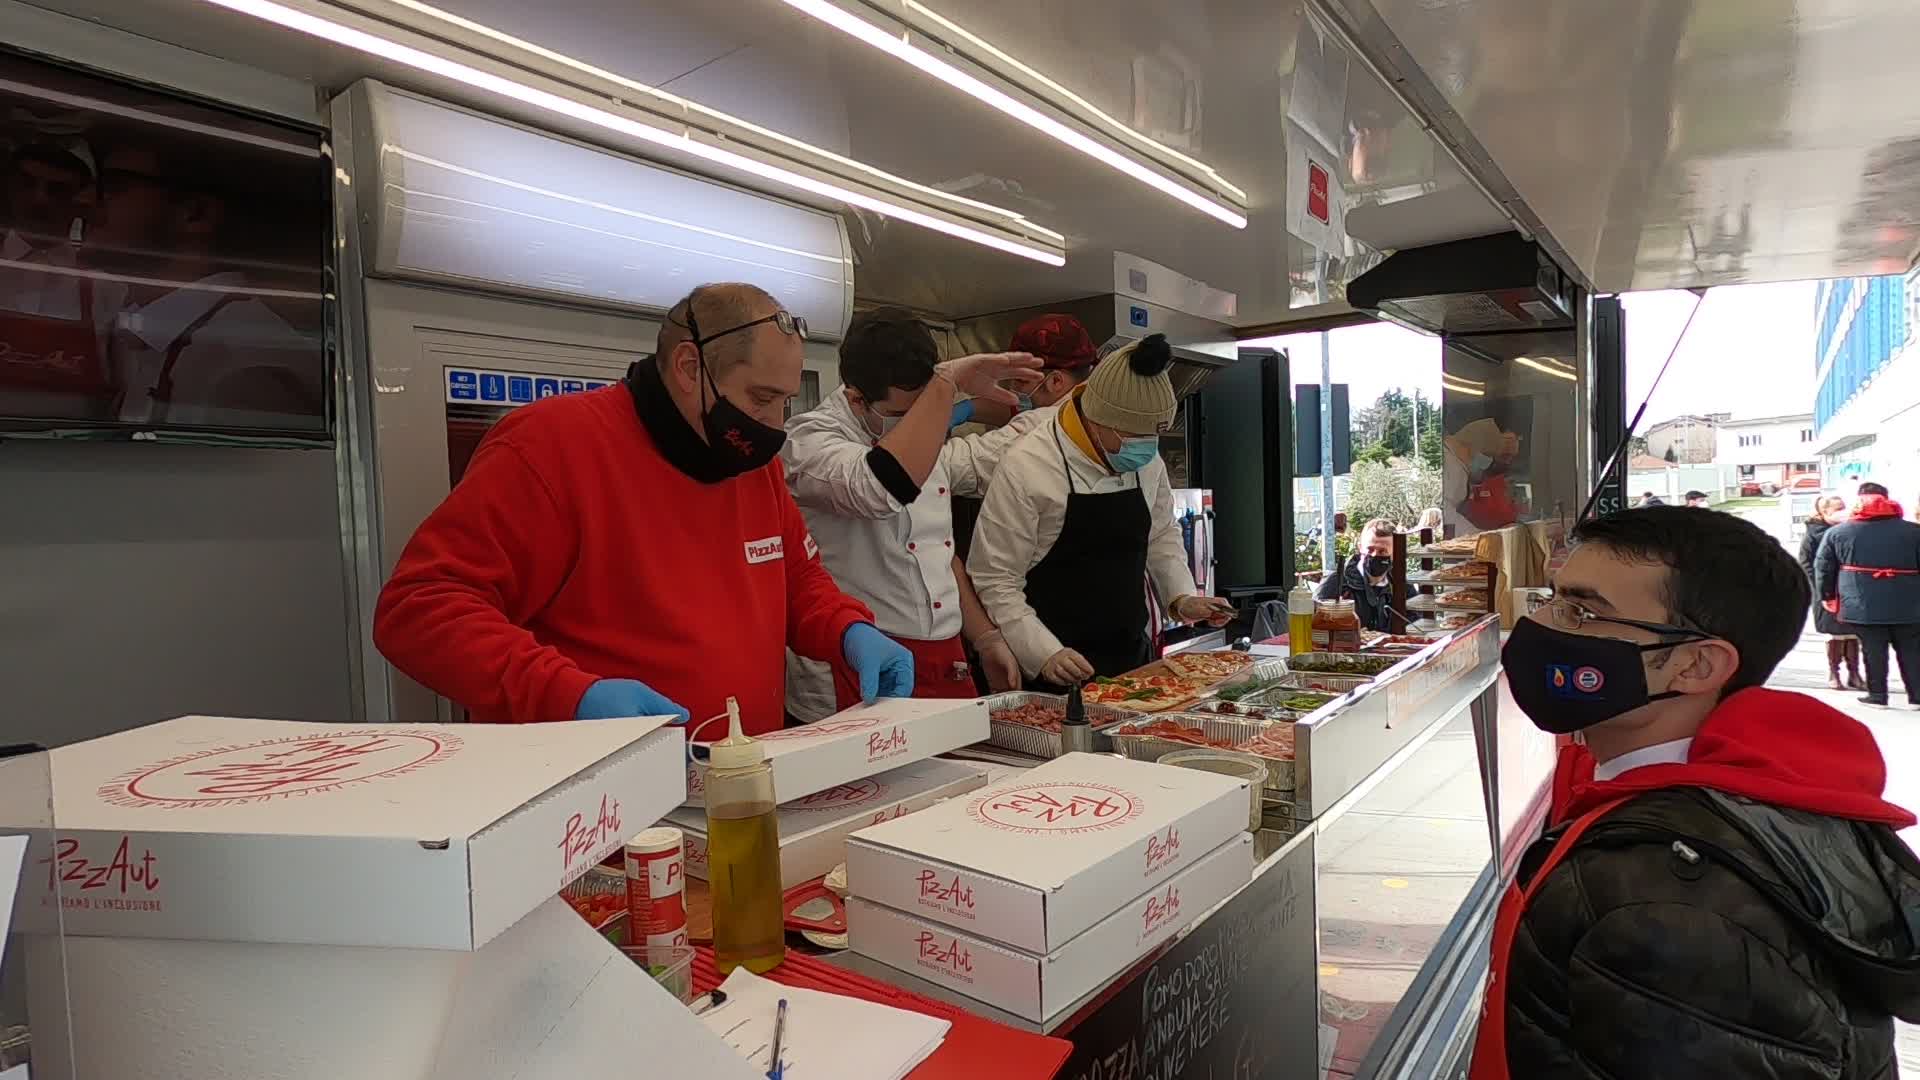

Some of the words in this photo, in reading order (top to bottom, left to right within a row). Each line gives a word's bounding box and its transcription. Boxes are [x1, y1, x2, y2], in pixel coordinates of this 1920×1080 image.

[557, 793, 622, 870] PizzAut
[39, 836, 160, 894] PizzAut
[915, 869, 975, 909] PizzAut
[913, 931, 973, 972] PizzAut
